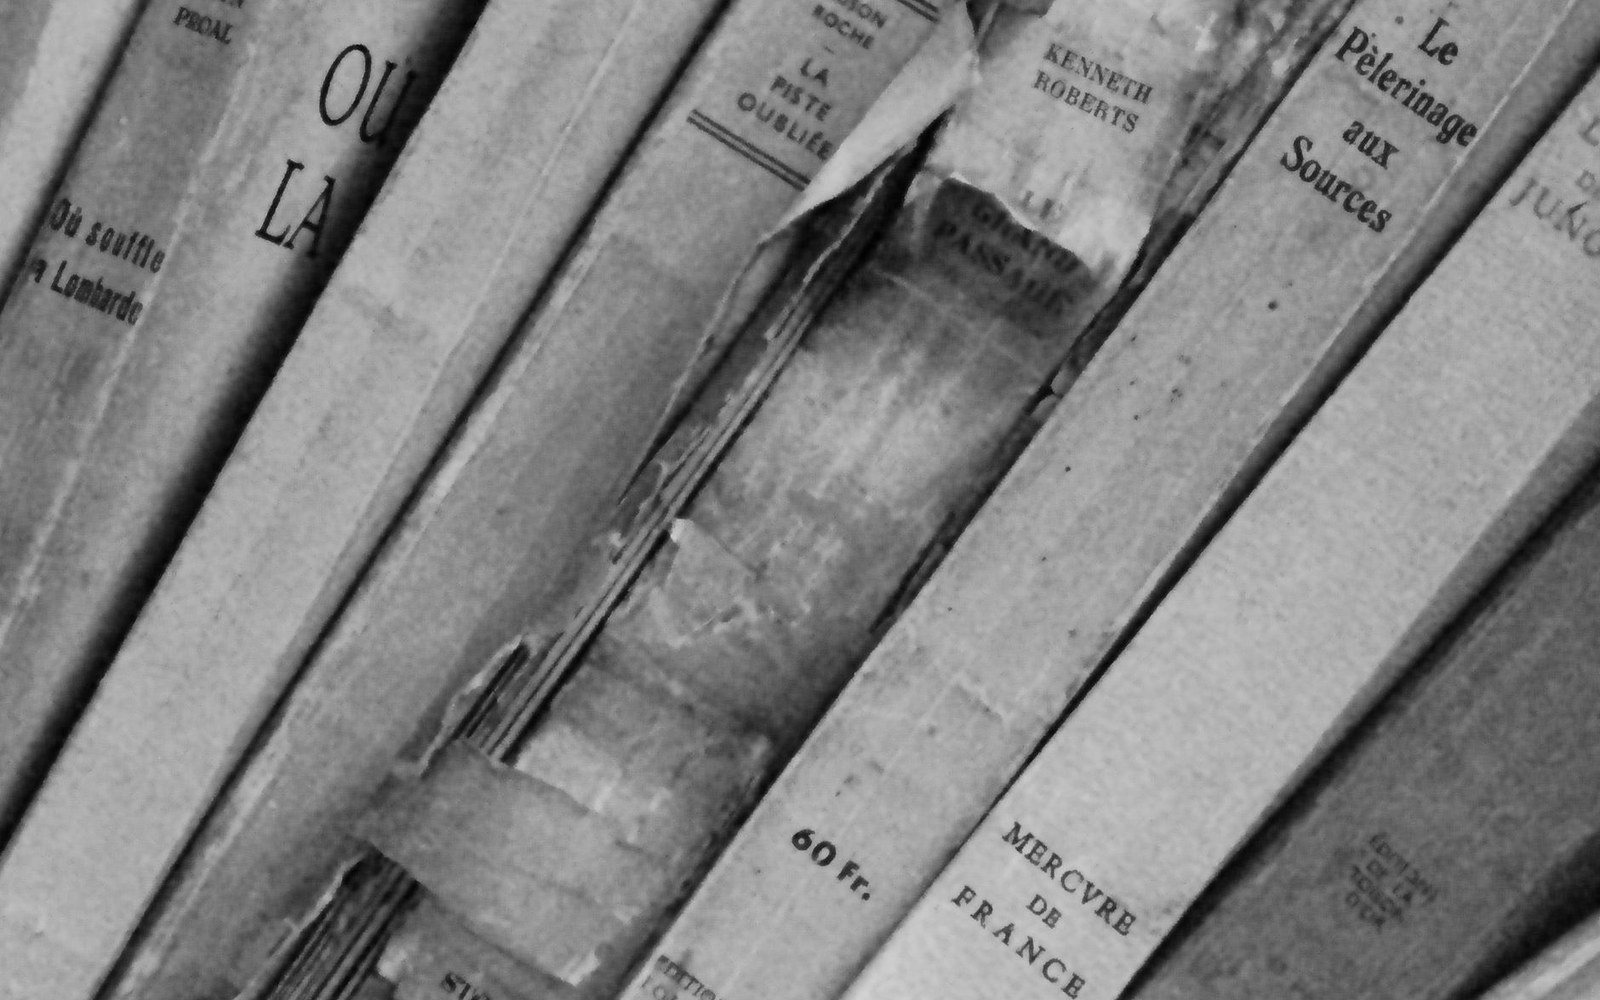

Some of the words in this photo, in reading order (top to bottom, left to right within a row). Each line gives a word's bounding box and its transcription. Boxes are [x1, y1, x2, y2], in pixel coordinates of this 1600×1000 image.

[799, 58, 829, 87] LA
[1417, 16, 1459, 66] Le
[770, 75, 832, 122] PISTE
[1032, 69, 1139, 134] ROBERTS
[1043, 42, 1154, 105] KENNETH
[1335, 26, 1478, 147] Pèlerinage
[1342, 120, 1400, 170] aux
[255, 159, 336, 260] LA
[1280, 135, 1392, 233] Sources
[85, 222, 165, 274] souffle
[791, 828, 836, 867] 60
[836, 860, 870, 901] Fr.
[1002, 821, 1136, 936] MERCVRE
[951, 885, 1086, 1000] FRANCE
[1026, 894, 1062, 929] DE
